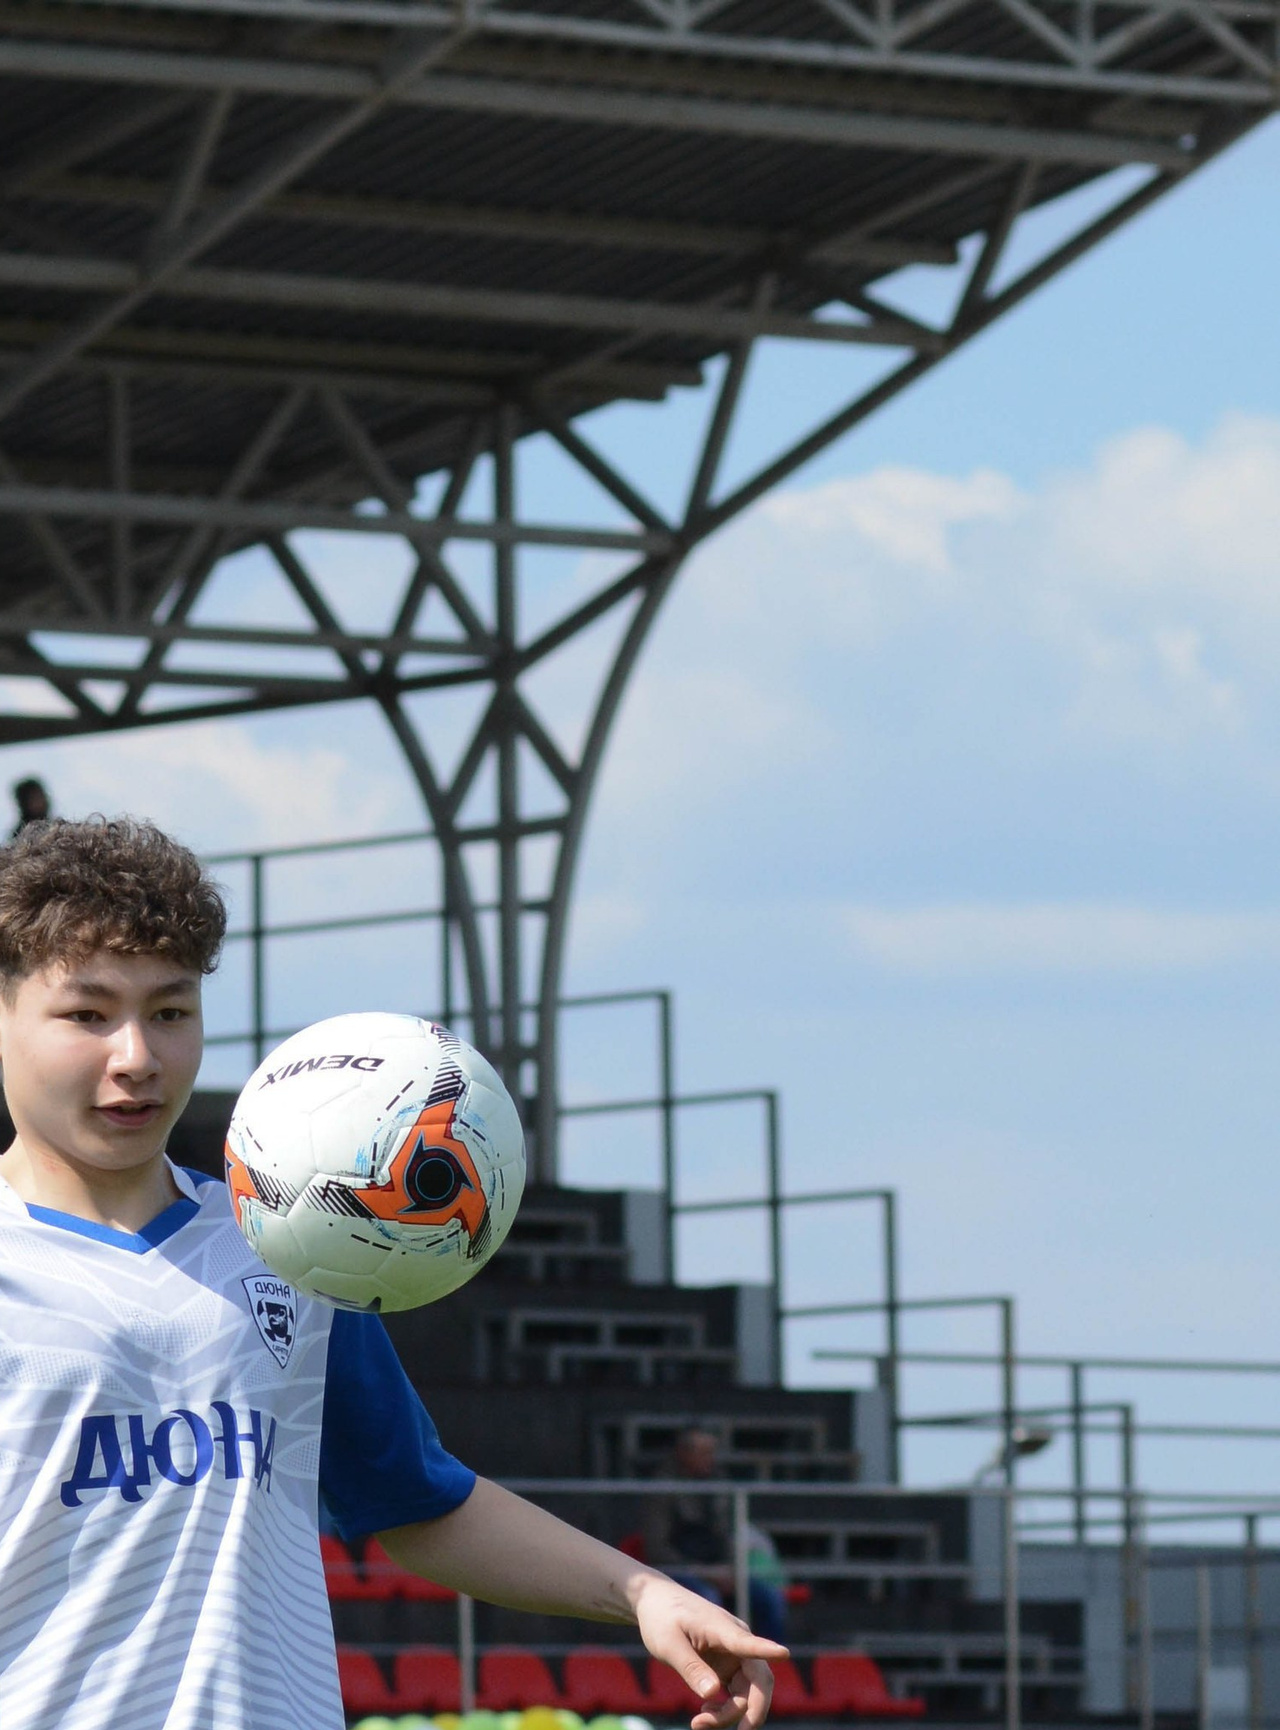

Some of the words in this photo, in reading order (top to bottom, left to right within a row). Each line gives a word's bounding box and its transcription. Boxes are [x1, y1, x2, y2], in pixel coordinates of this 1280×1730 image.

[258, 1055, 385, 1091] DEMIX
[254, 1281, 291, 1299] ДЮНА
[61, 1401, 277, 1507] ДЮНА
